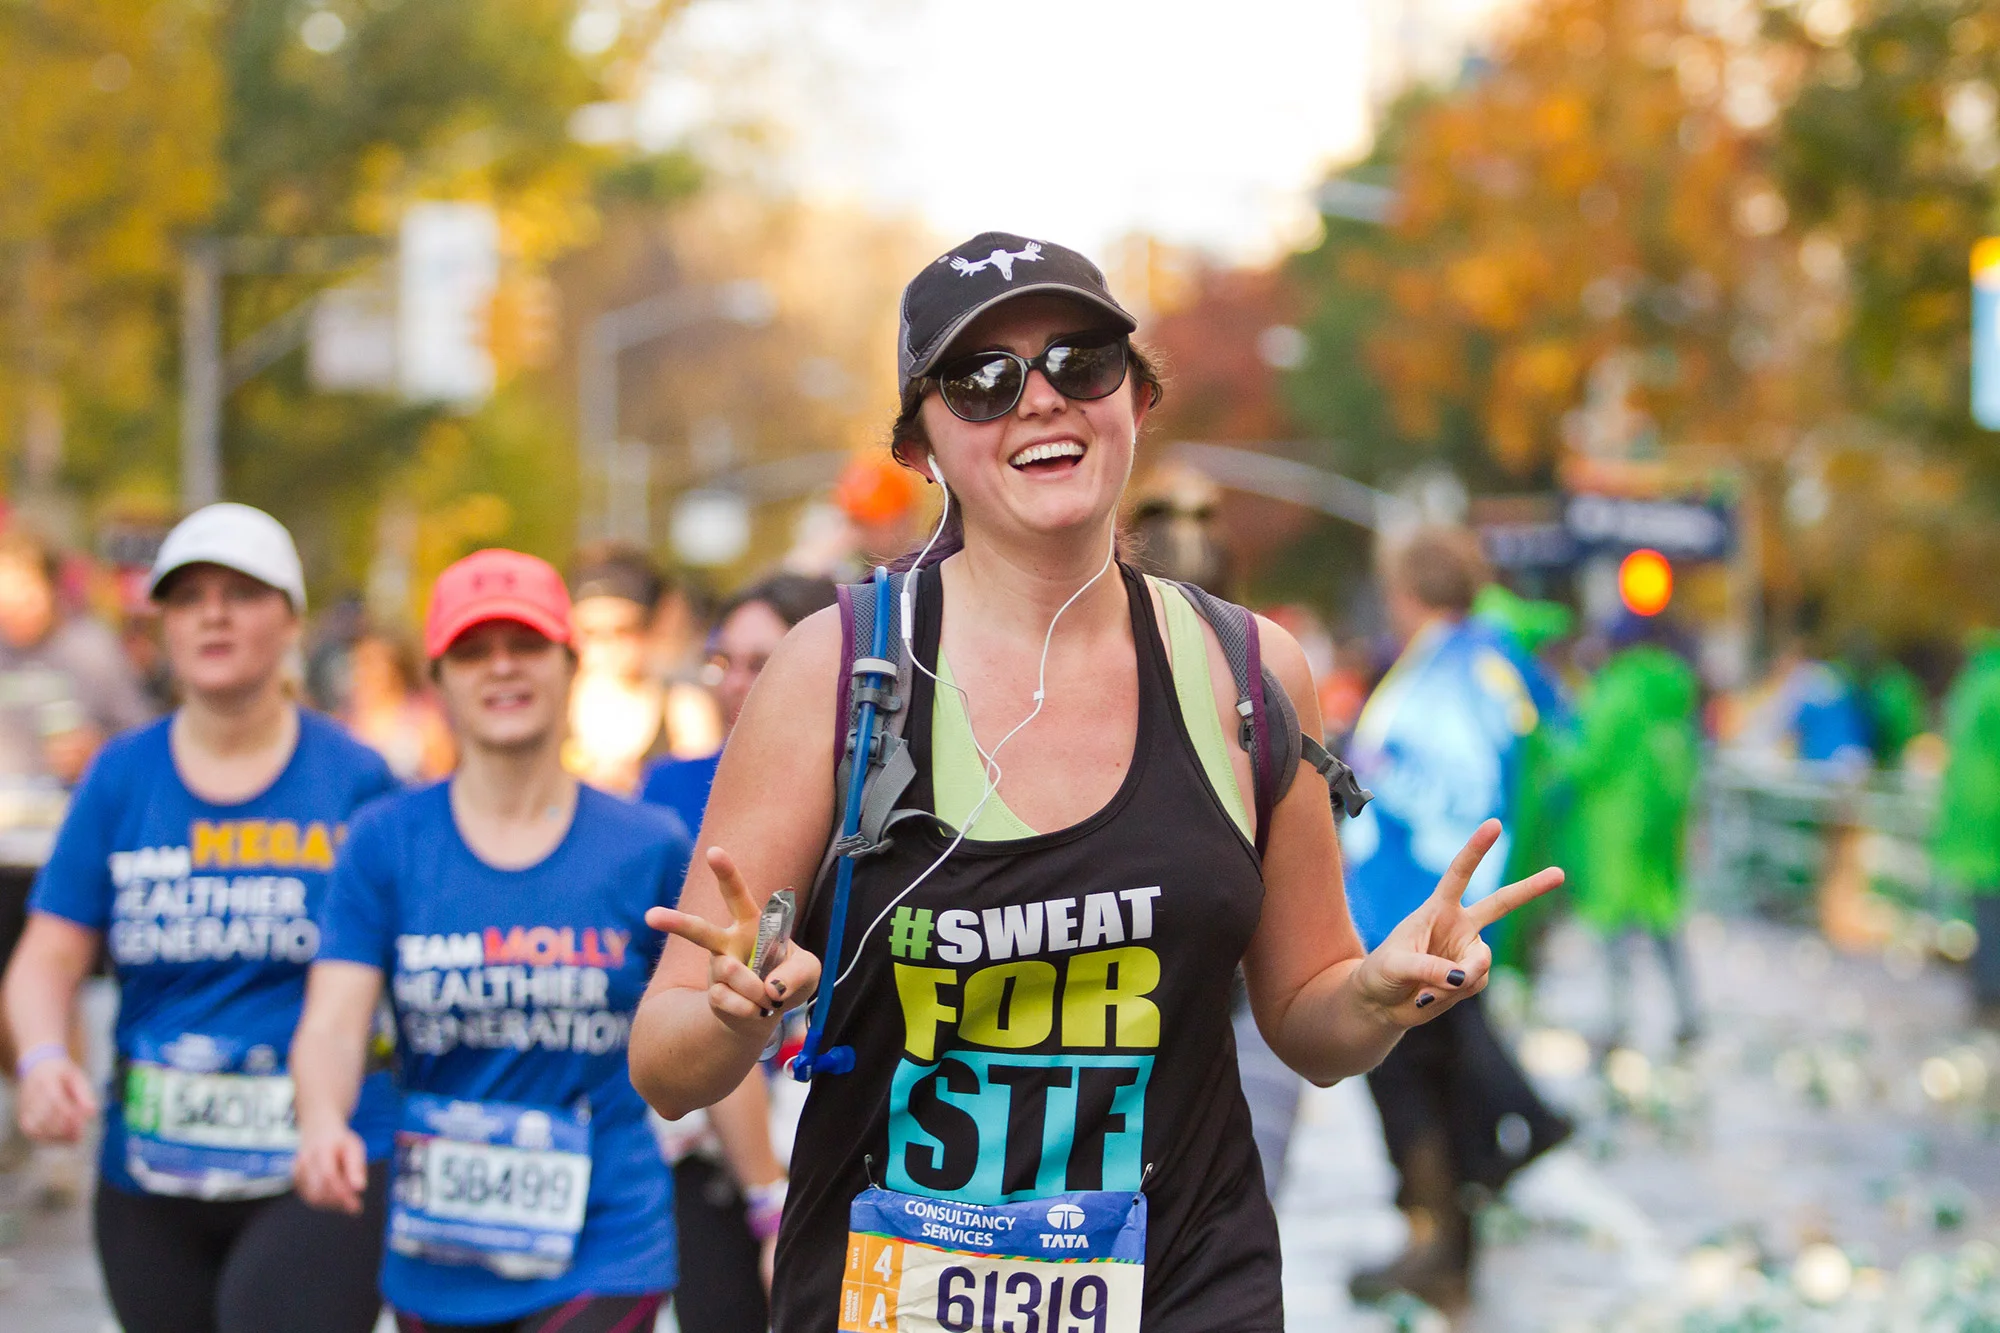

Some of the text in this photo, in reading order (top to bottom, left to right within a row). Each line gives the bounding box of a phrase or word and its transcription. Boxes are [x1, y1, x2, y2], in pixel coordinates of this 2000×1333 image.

[190, 818, 348, 873] MEGA
[113, 876, 308, 919] EALTHIER
[109, 915, 321, 965] GENERATIO
[483, 925, 632, 970] MOLLY
[888, 886, 1162, 963] #SWEAT
[893, 946, 1161, 1061] FOR
[896, 1054, 1146, 1198] STF
[440, 1154, 574, 1212] 58499
[904, 1200, 1017, 1231] CONSULTANCY
[921, 1222, 994, 1247] SERVICES
[1039, 1233, 1089, 1248] TATA
[873, 1244, 893, 1282] 4
[936, 1266, 1109, 1333] 61319
